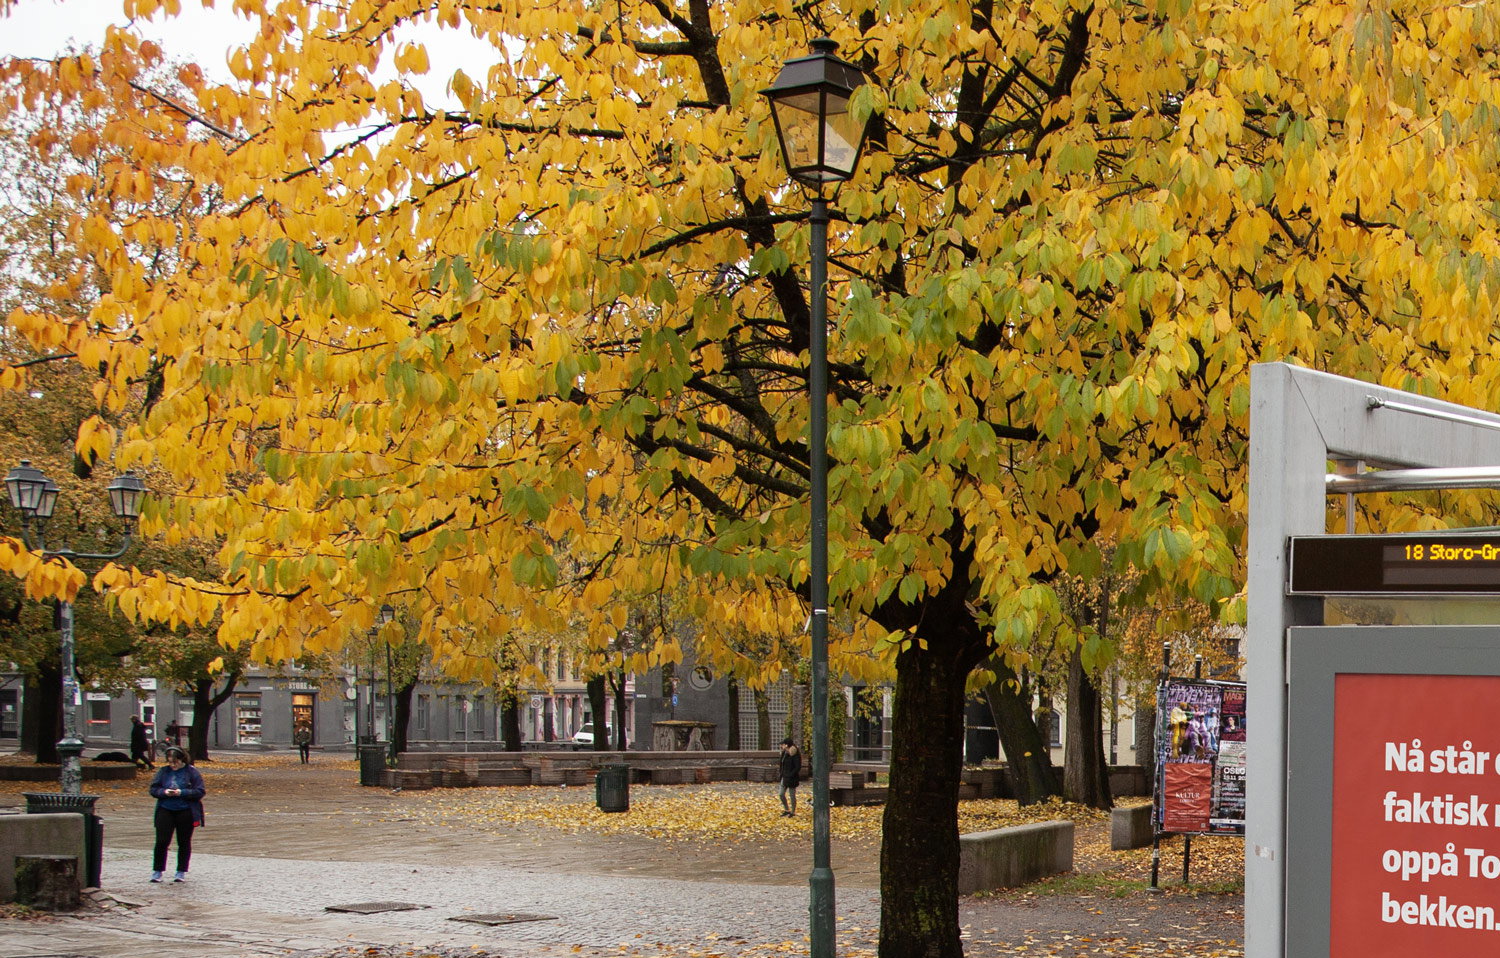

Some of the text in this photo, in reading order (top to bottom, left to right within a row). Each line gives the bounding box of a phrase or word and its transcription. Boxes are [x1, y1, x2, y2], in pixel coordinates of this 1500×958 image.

[1405, 544, 1424, 560] 18
[1385, 738, 1424, 772] Nå
[1430, 740, 1490, 775] står
[1383, 791, 1489, 827] faktisk
[1382, 842, 1458, 882] oppå
